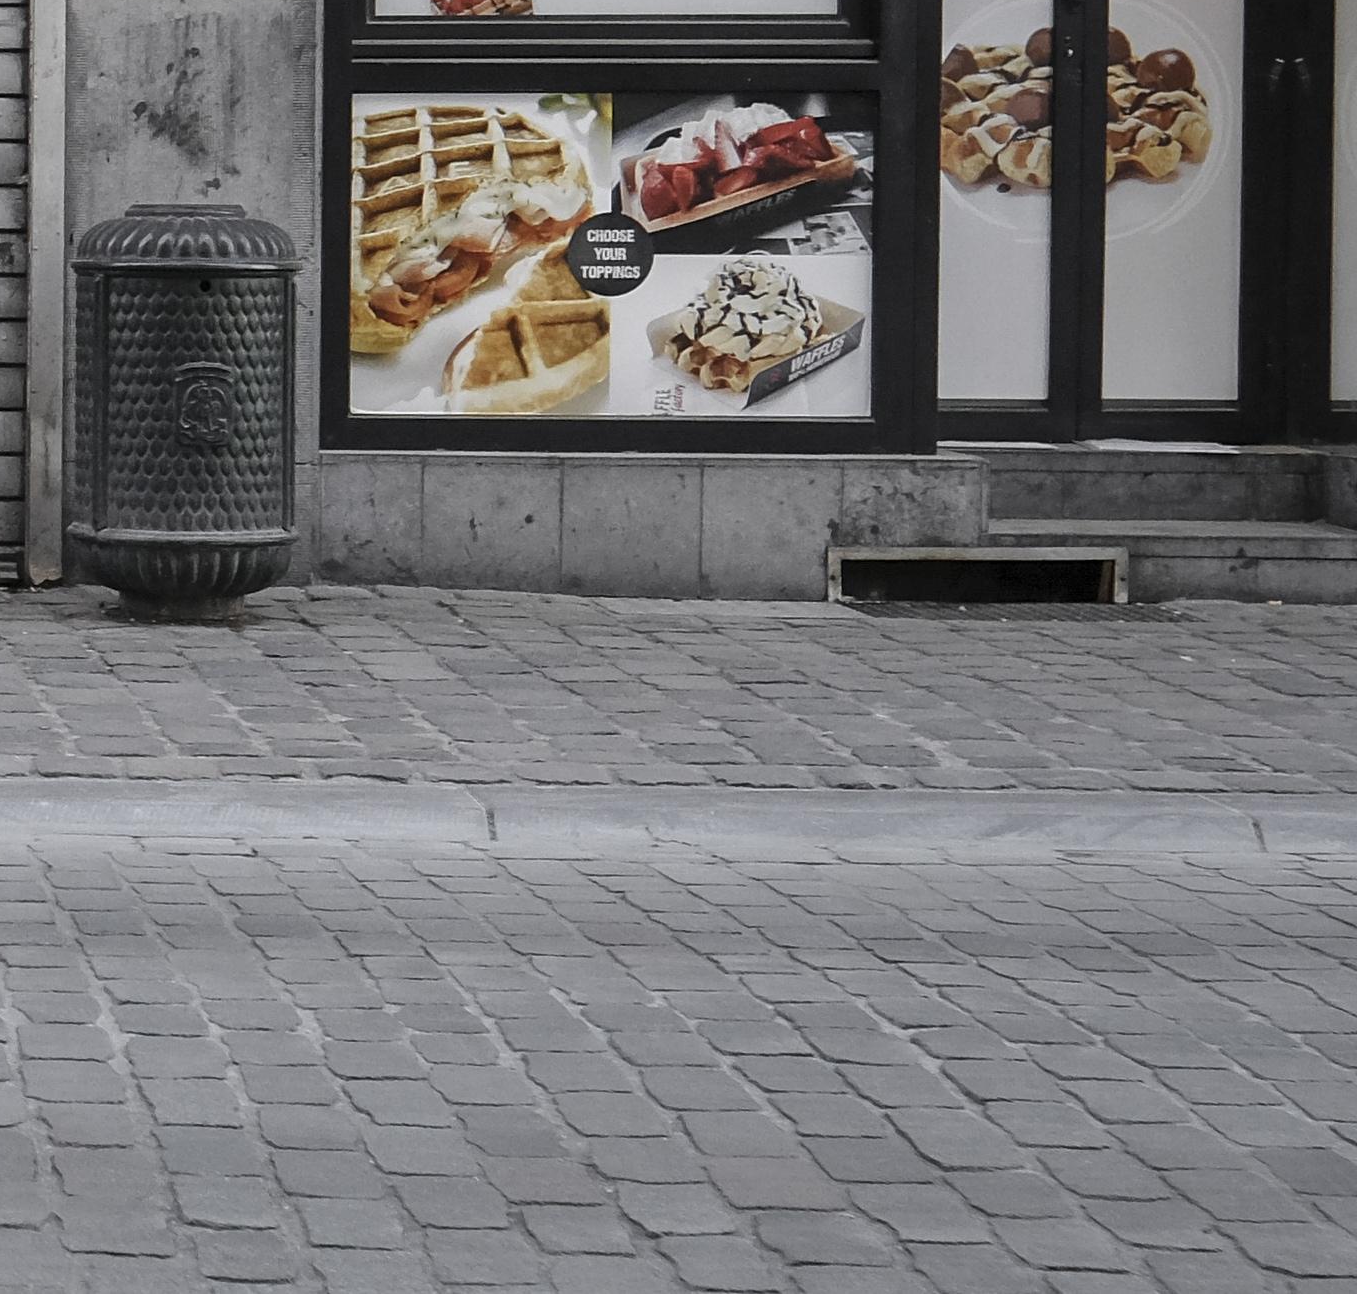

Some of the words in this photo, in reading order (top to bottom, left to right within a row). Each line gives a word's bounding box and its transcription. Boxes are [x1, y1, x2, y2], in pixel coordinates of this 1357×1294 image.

[587, 229, 635, 242] CHOOSE
[593, 247, 627, 261] YOUR
[580, 265, 640, 279] TOPPINGS
[791, 335, 846, 372] WAFFLES
